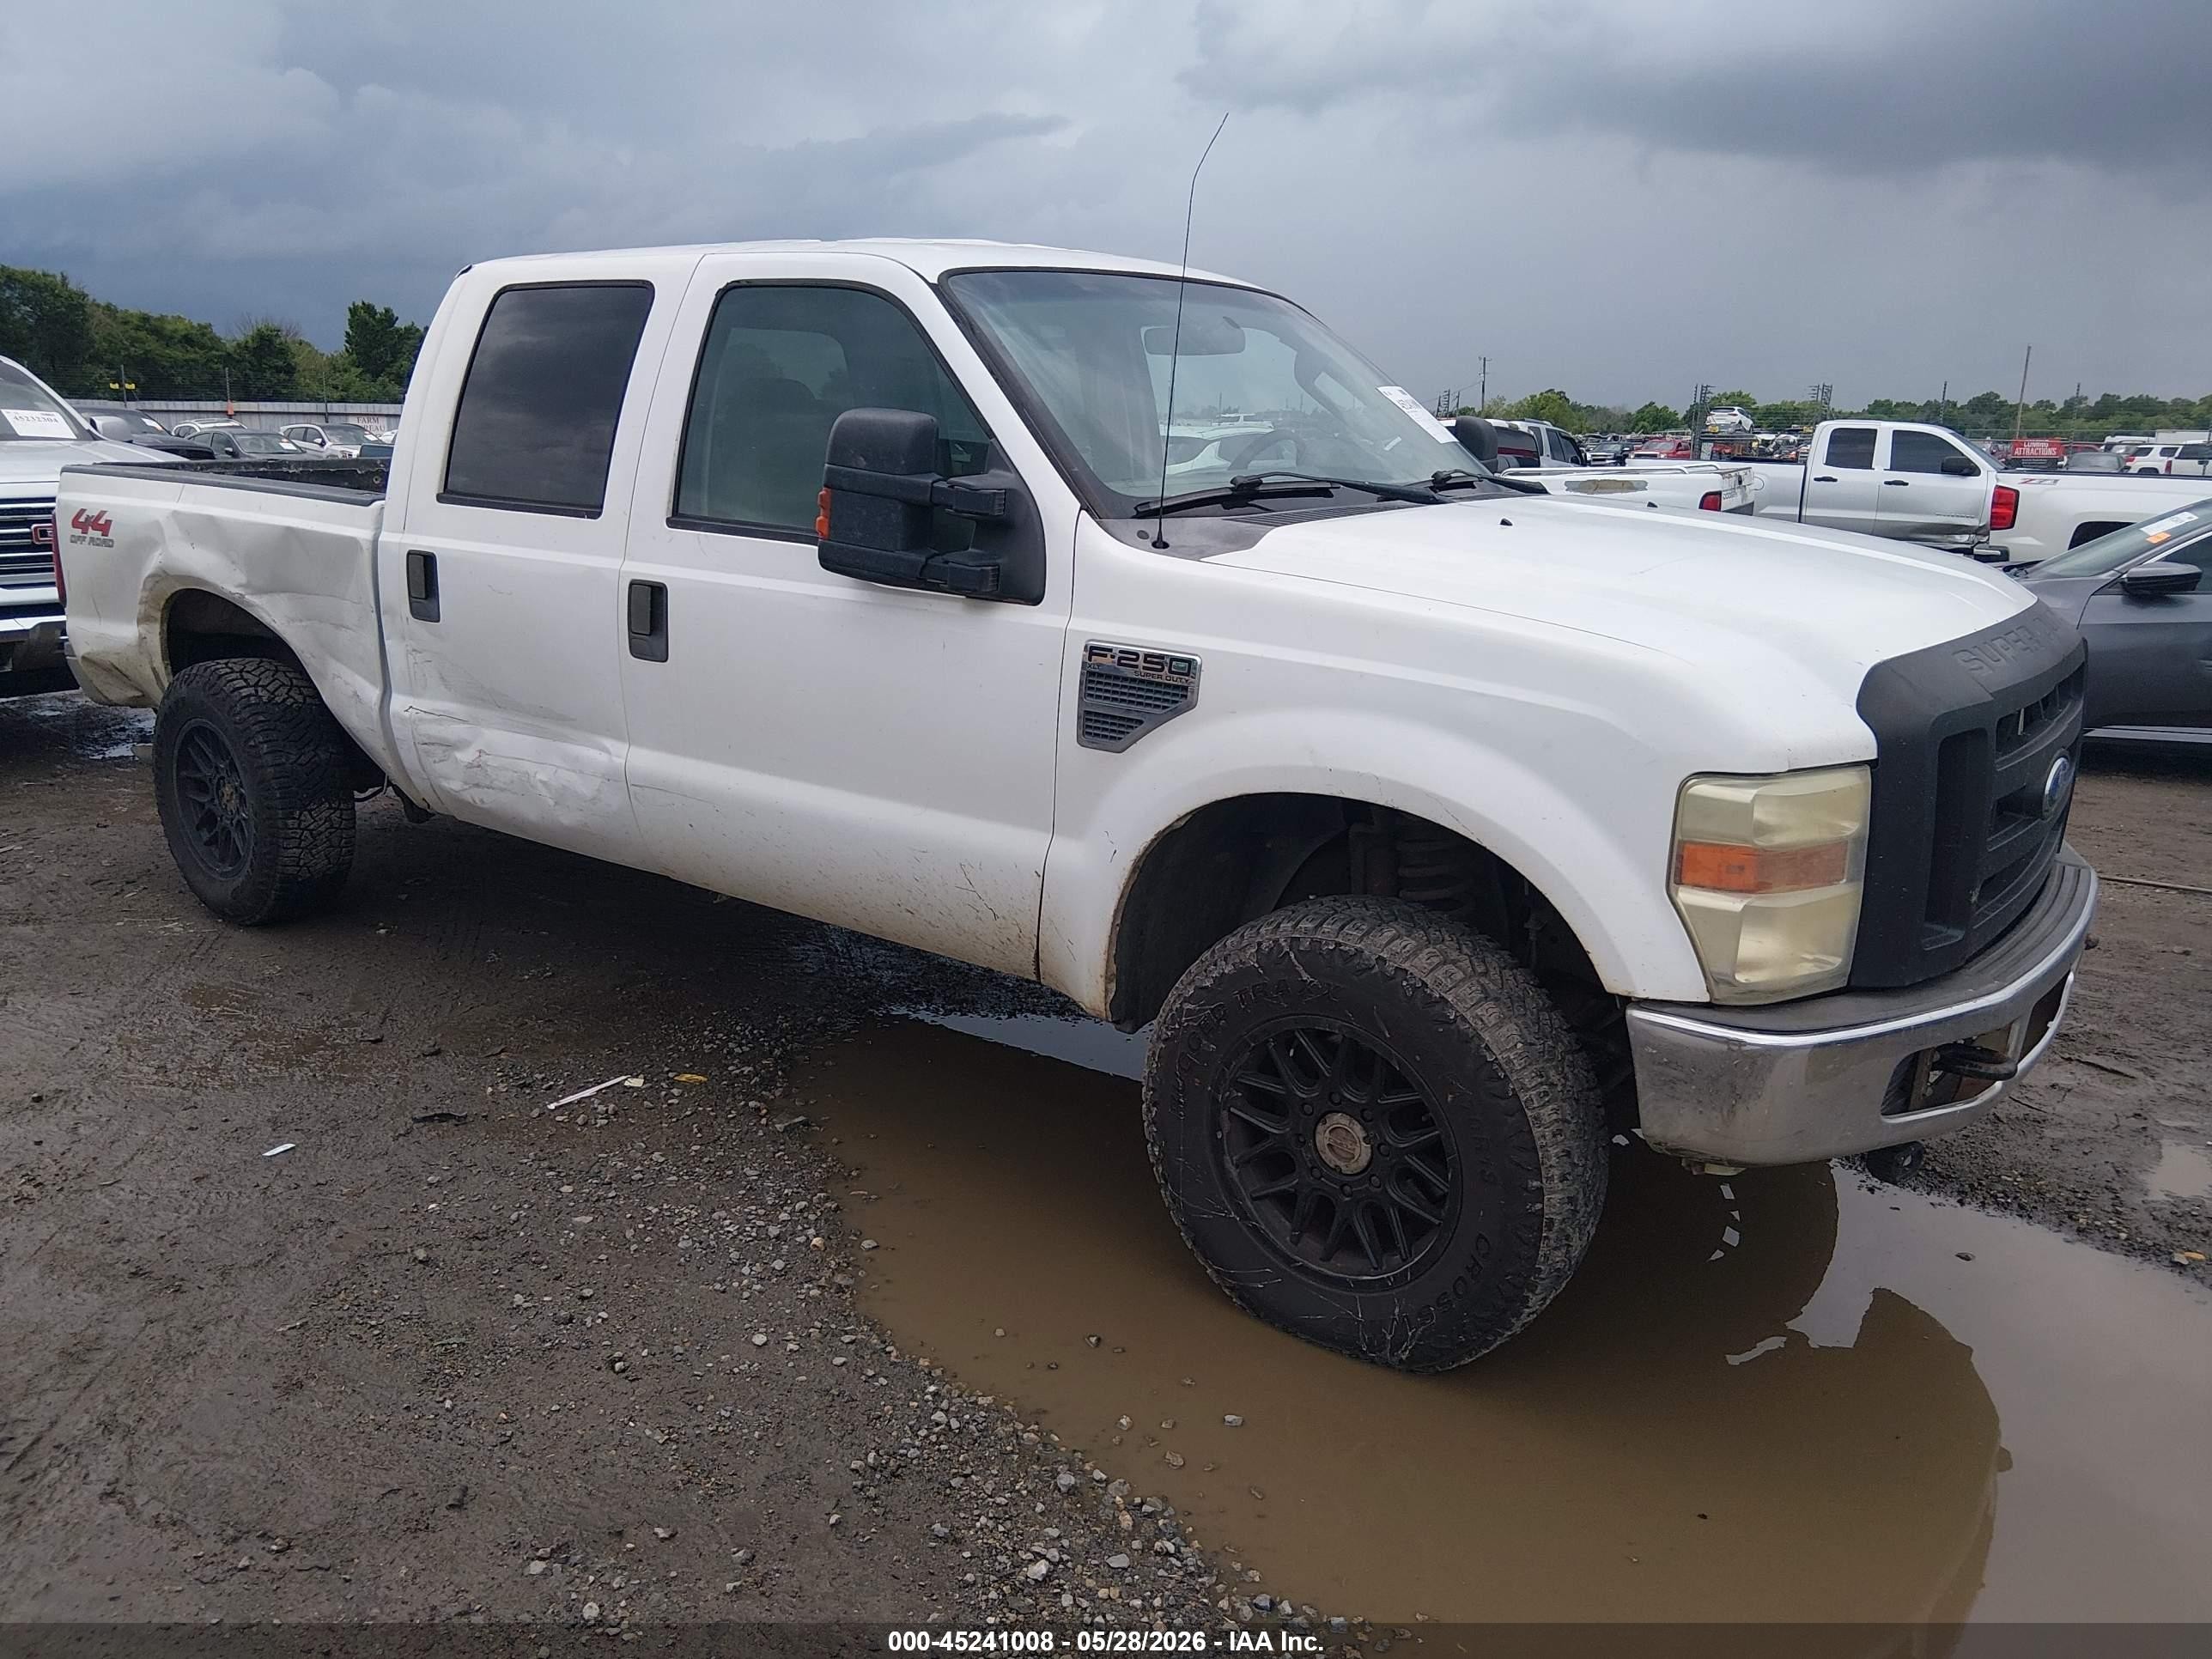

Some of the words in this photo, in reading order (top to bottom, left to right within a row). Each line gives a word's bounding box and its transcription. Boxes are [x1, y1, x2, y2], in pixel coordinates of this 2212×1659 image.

[70, 534, 87, 544] OFF
[88, 537, 114, 548] ROAD
[1087, 645, 1192, 677] F-250
[1133, 671, 1163, 680] SUPER
